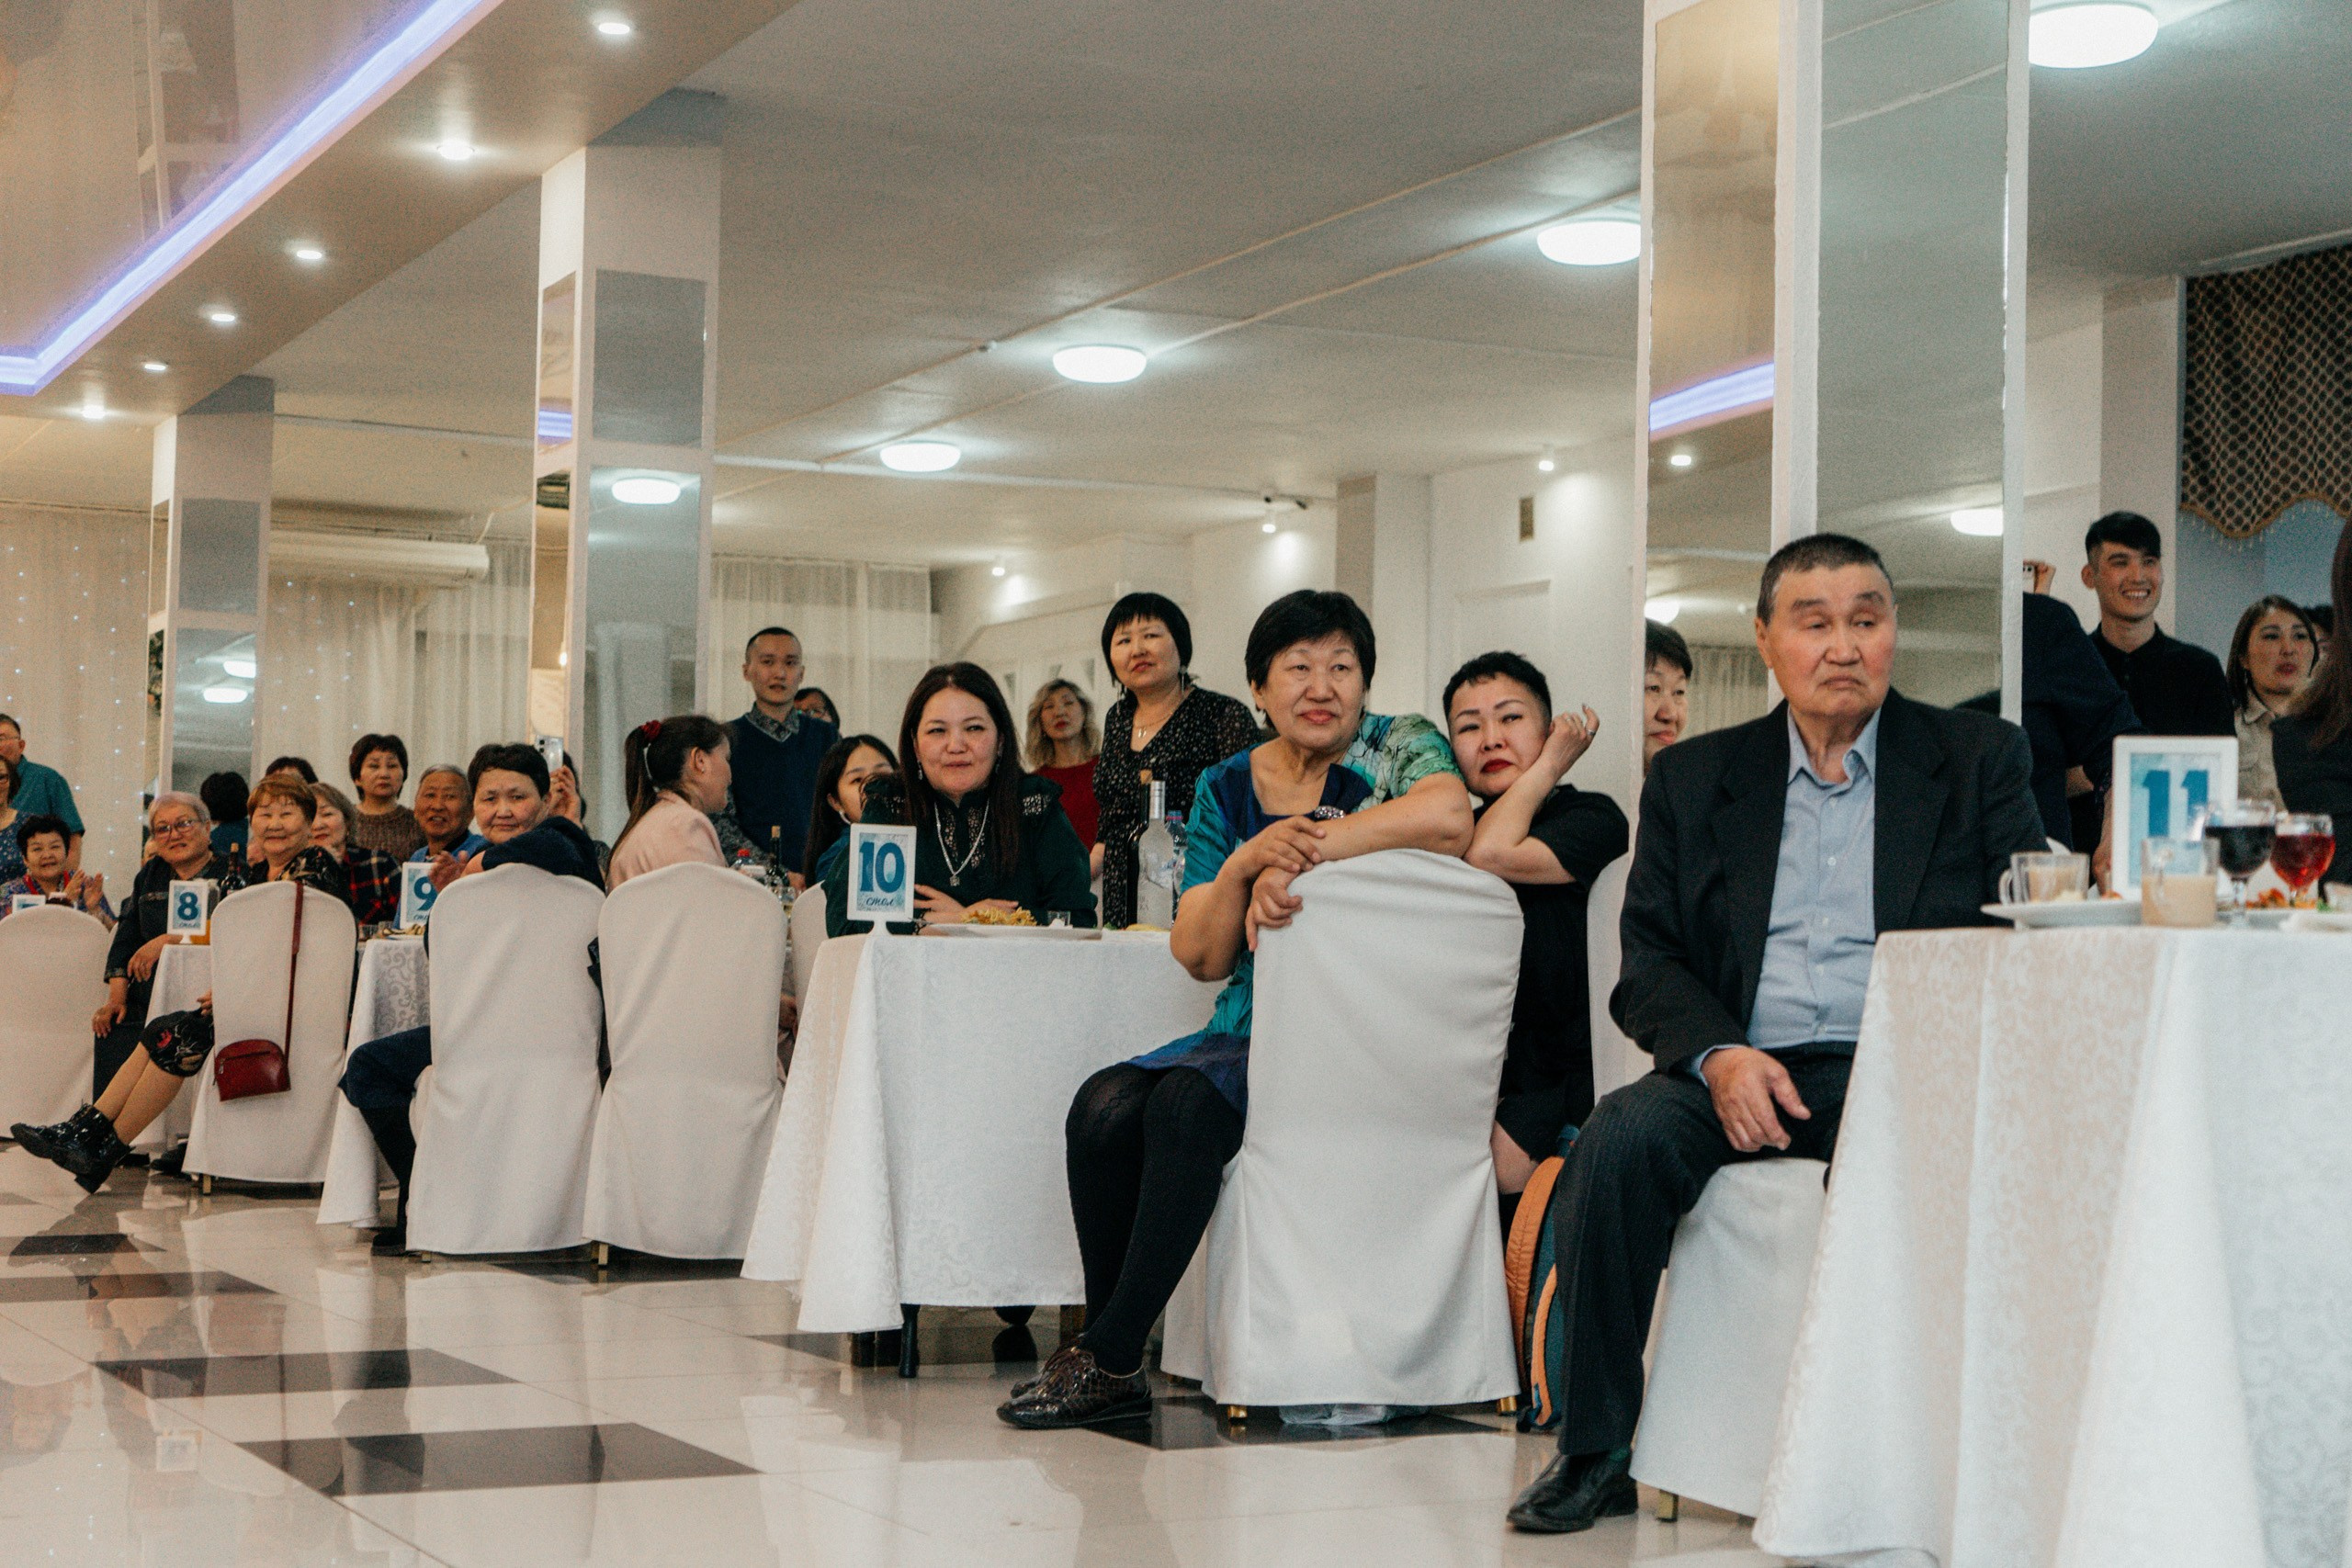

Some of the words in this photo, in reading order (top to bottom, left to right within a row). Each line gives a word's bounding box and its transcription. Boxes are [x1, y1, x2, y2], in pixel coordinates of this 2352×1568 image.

[2143, 770, 2209, 850] 11
[859, 841, 905, 893] 10
[177, 892, 198, 920] 8
[413, 876, 438, 911] 9
[866, 897, 893, 907] стол
